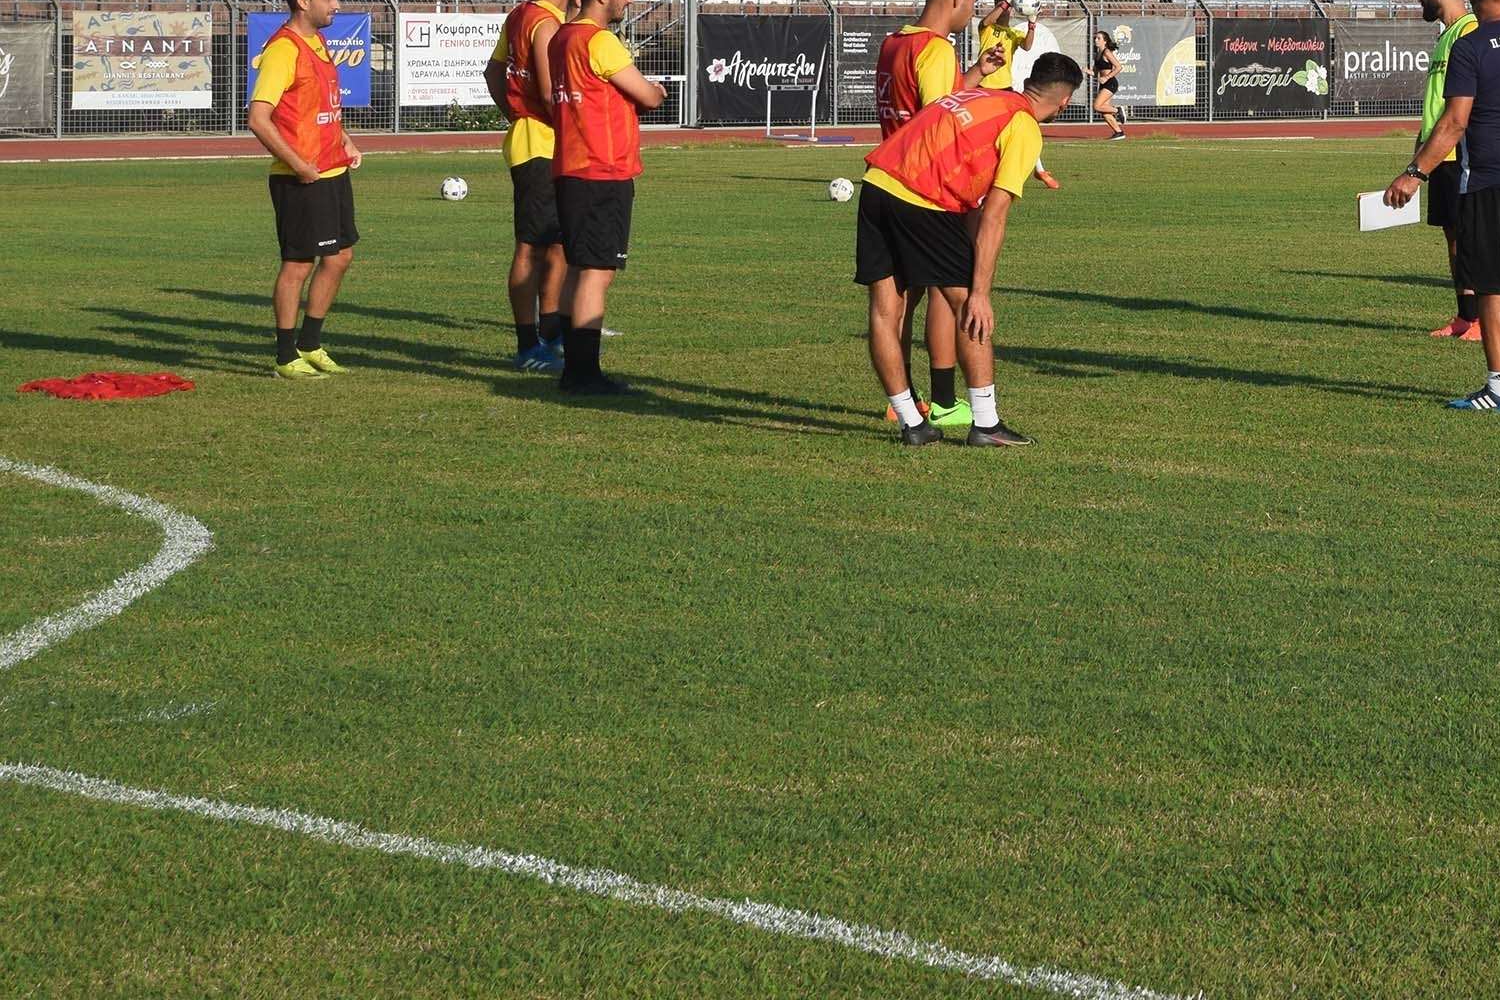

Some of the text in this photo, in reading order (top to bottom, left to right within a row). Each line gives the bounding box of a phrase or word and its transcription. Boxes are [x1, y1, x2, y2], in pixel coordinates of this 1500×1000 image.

[435, 23, 484, 36] Κοψάρης
[85, 40, 204, 53] ΑΓΝΑΝΤΙ
[440, 39, 497, 48] ΓΕΝΙΚΟ ΕΜΠΟ
[1344, 40, 1430, 79] praline
[456, 70, 484, 78] ΗΛΕΚΤΡ
[726, 50, 816, 91] Αγράμπελη
